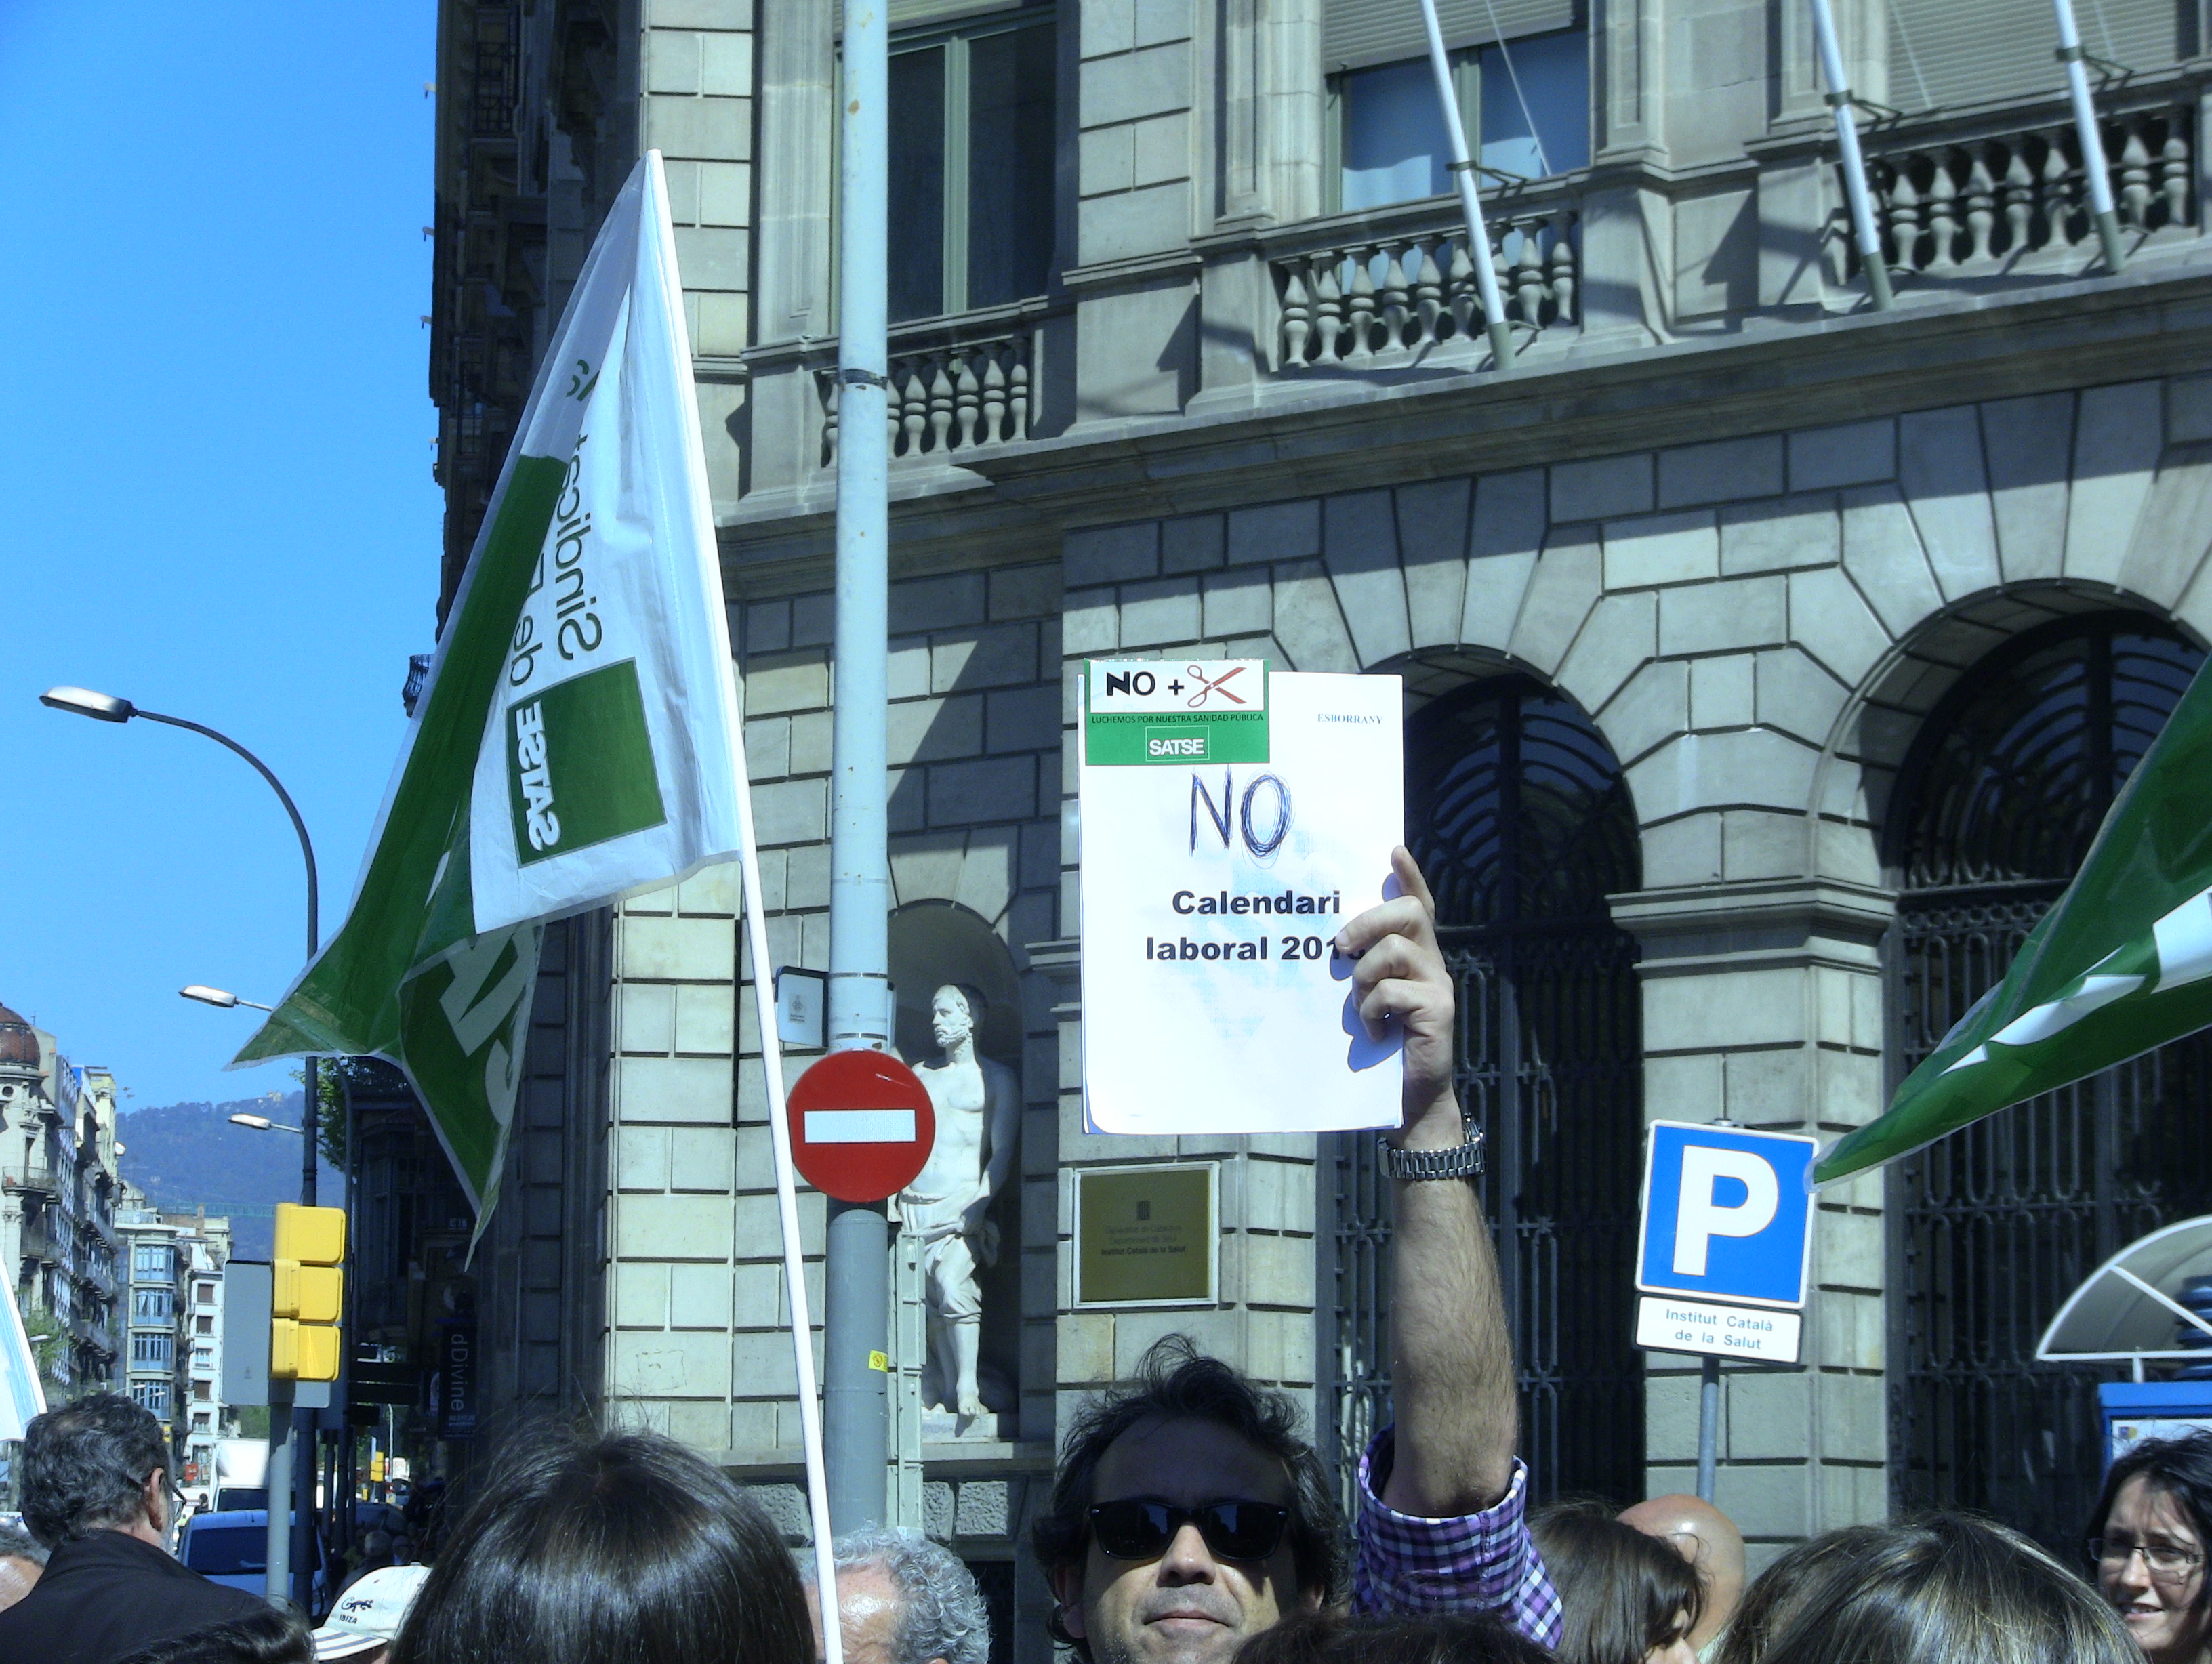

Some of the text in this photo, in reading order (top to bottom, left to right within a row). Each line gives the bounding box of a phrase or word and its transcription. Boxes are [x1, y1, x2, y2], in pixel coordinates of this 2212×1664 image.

[1106, 671, 1156, 696] NO
[1138, 715, 1153, 724] POR
[1155, 715, 1192, 723] NUESTRA
[1193, 714, 1229, 722] SANIDAD
[1231, 713, 1264, 722] PÚBLICA
[1317, 713, 1383, 724] ESBORRANY
[1149, 739, 1205, 756] SATSE
[1189, 766, 1295, 866] NO
[1172, 890, 1340, 915] Calendari
[1146, 936, 1366, 961] laboral 201
[1673, 1144, 1780, 1276] P
[1666, 1308, 1774, 1332] Institut Català
[1675, 1329, 1762, 1350] de la Salut
[339, 1613, 358, 1624] IBIZA
